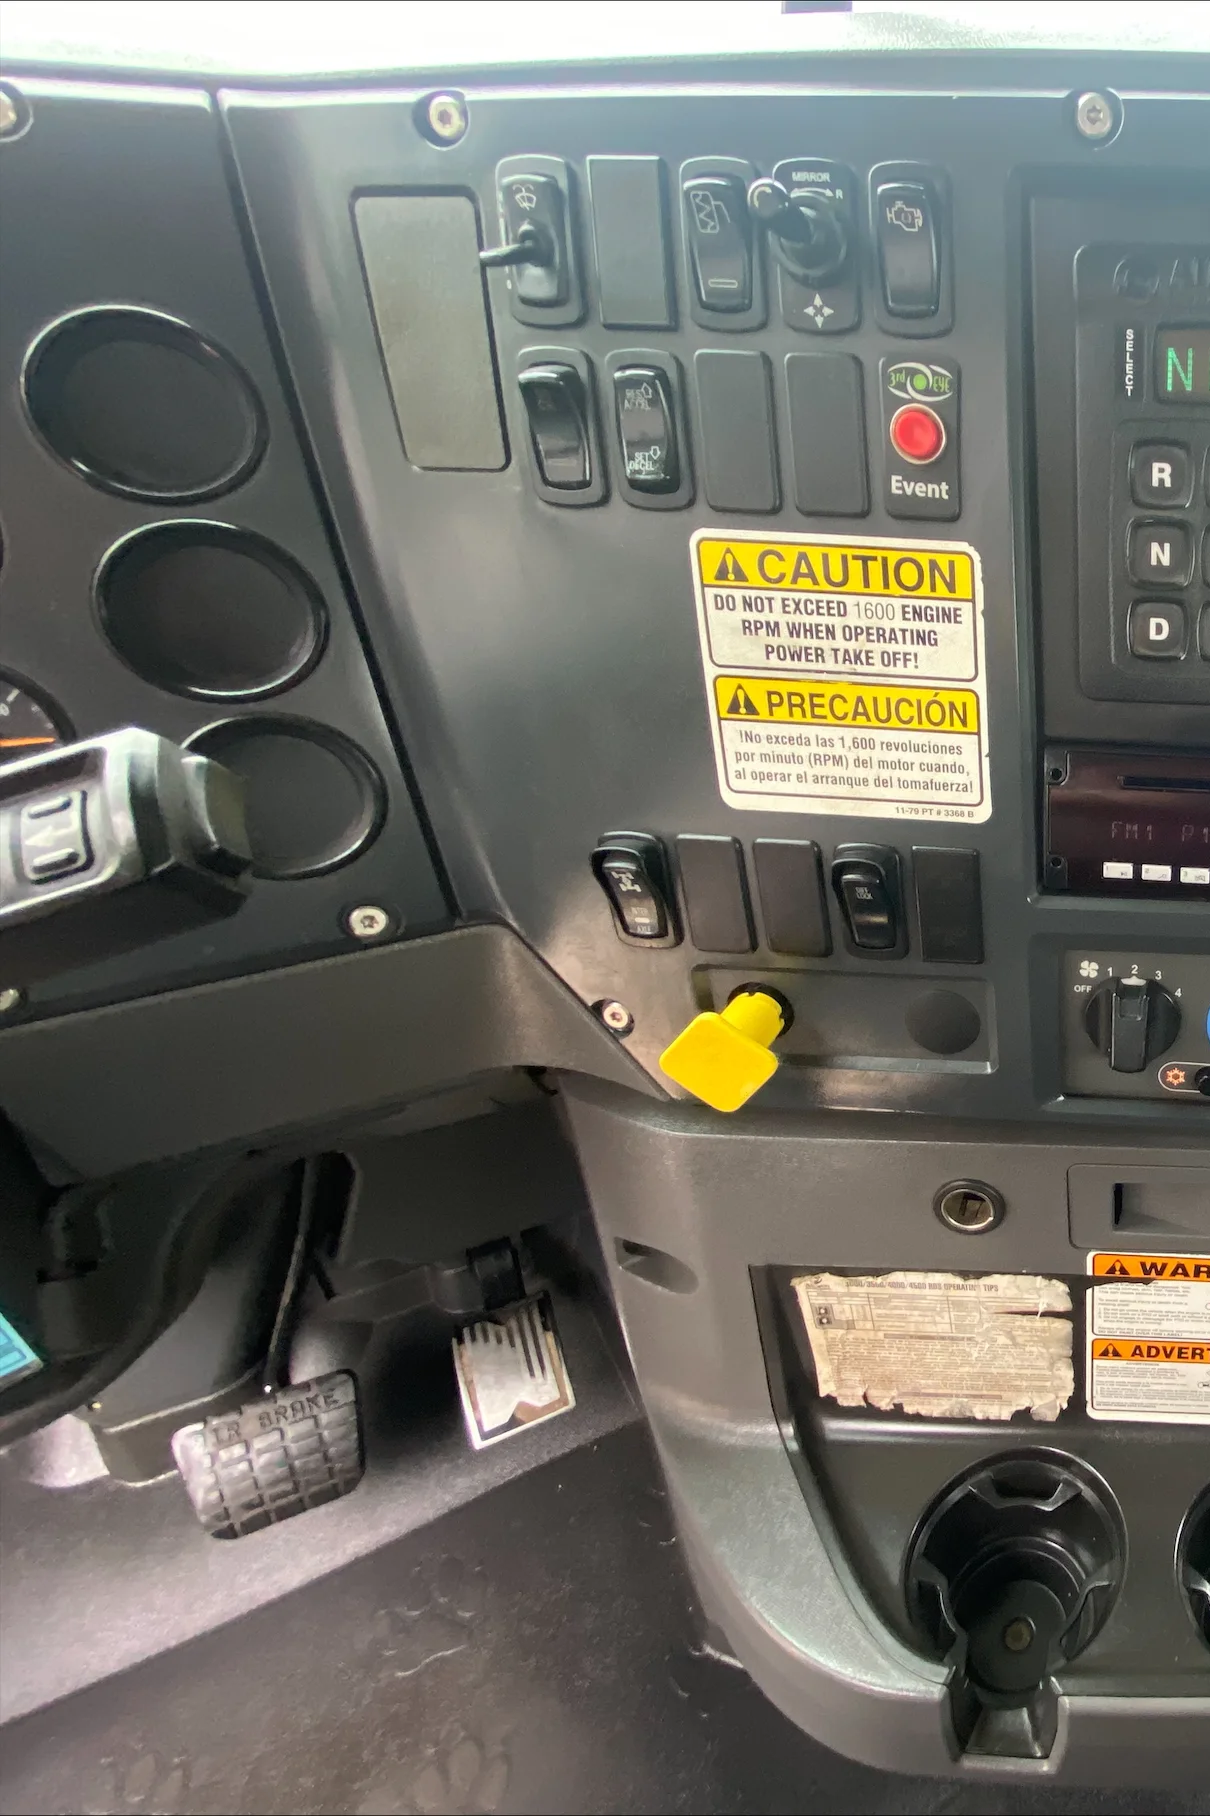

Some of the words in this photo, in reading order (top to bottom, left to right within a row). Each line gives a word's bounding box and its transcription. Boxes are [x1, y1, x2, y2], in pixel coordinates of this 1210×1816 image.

[791, 171, 831, 182] MIRROR
[835, 189, 843, 199] R
[1125, 328, 1134, 396] SELECT
[1167, 347, 1193, 392] N
[635, 452, 649, 462] SET
[891, 475, 949, 499] Event
[1151, 462, 1172, 488] R
[1150, 542, 1171, 567] N
[757, 549, 957, 594] CAUTION
[714, 594, 736, 611] DO
[743, 595, 775, 613] NOT
[782, 597, 847, 618] EXCEED
[854, 602, 895, 620] 1600
[901, 604, 963, 624] ENGINE
[742, 619, 781, 637] RPM
[786, 621, 836, 640] WHEN
[842, 625, 938, 647] OPERATING
[1149, 618, 1170, 641] D
[765, 644, 826, 663] POWER
[832, 647, 874, 666] TAKE
[880, 650, 919, 669] OFF!
[766, 689, 968, 728] PRECAUCIÓN
[766, 733, 811, 747] exceda
[815, 734, 835, 748] las
[838, 736, 876, 751] 1,600
[880, 740, 963, 756] revoluciones
[734, 751, 755, 763] por
[760, 751, 804, 765] minuto
[808, 752, 849, 770] (RPM)
[853, 756, 873, 769] del
[878, 759, 915, 771] motor
[919, 761, 970, 776] cuando,
[734, 767, 747, 780] al
[750, 769, 792, 783] operar
[796, 771, 808, 783] el
[812, 774, 869, 788] arranque
[873, 776, 893, 788] del
[897, 777, 974, 793] tomafuerza!
[895, 806, 919, 815] 11-79
[922, 808, 934, 816] PT
[944, 809, 965, 817] 3368
[967, 810, 974, 818] B
[1073, 984, 1093, 993] OFF
[1107, 966, 1113, 977] 1
[1131, 964, 1139, 975] 2
[1155, 970, 1162, 980] 3
[1174, 987, 1182, 998] 4
[983, 1284, 999, 1292] TIPS
